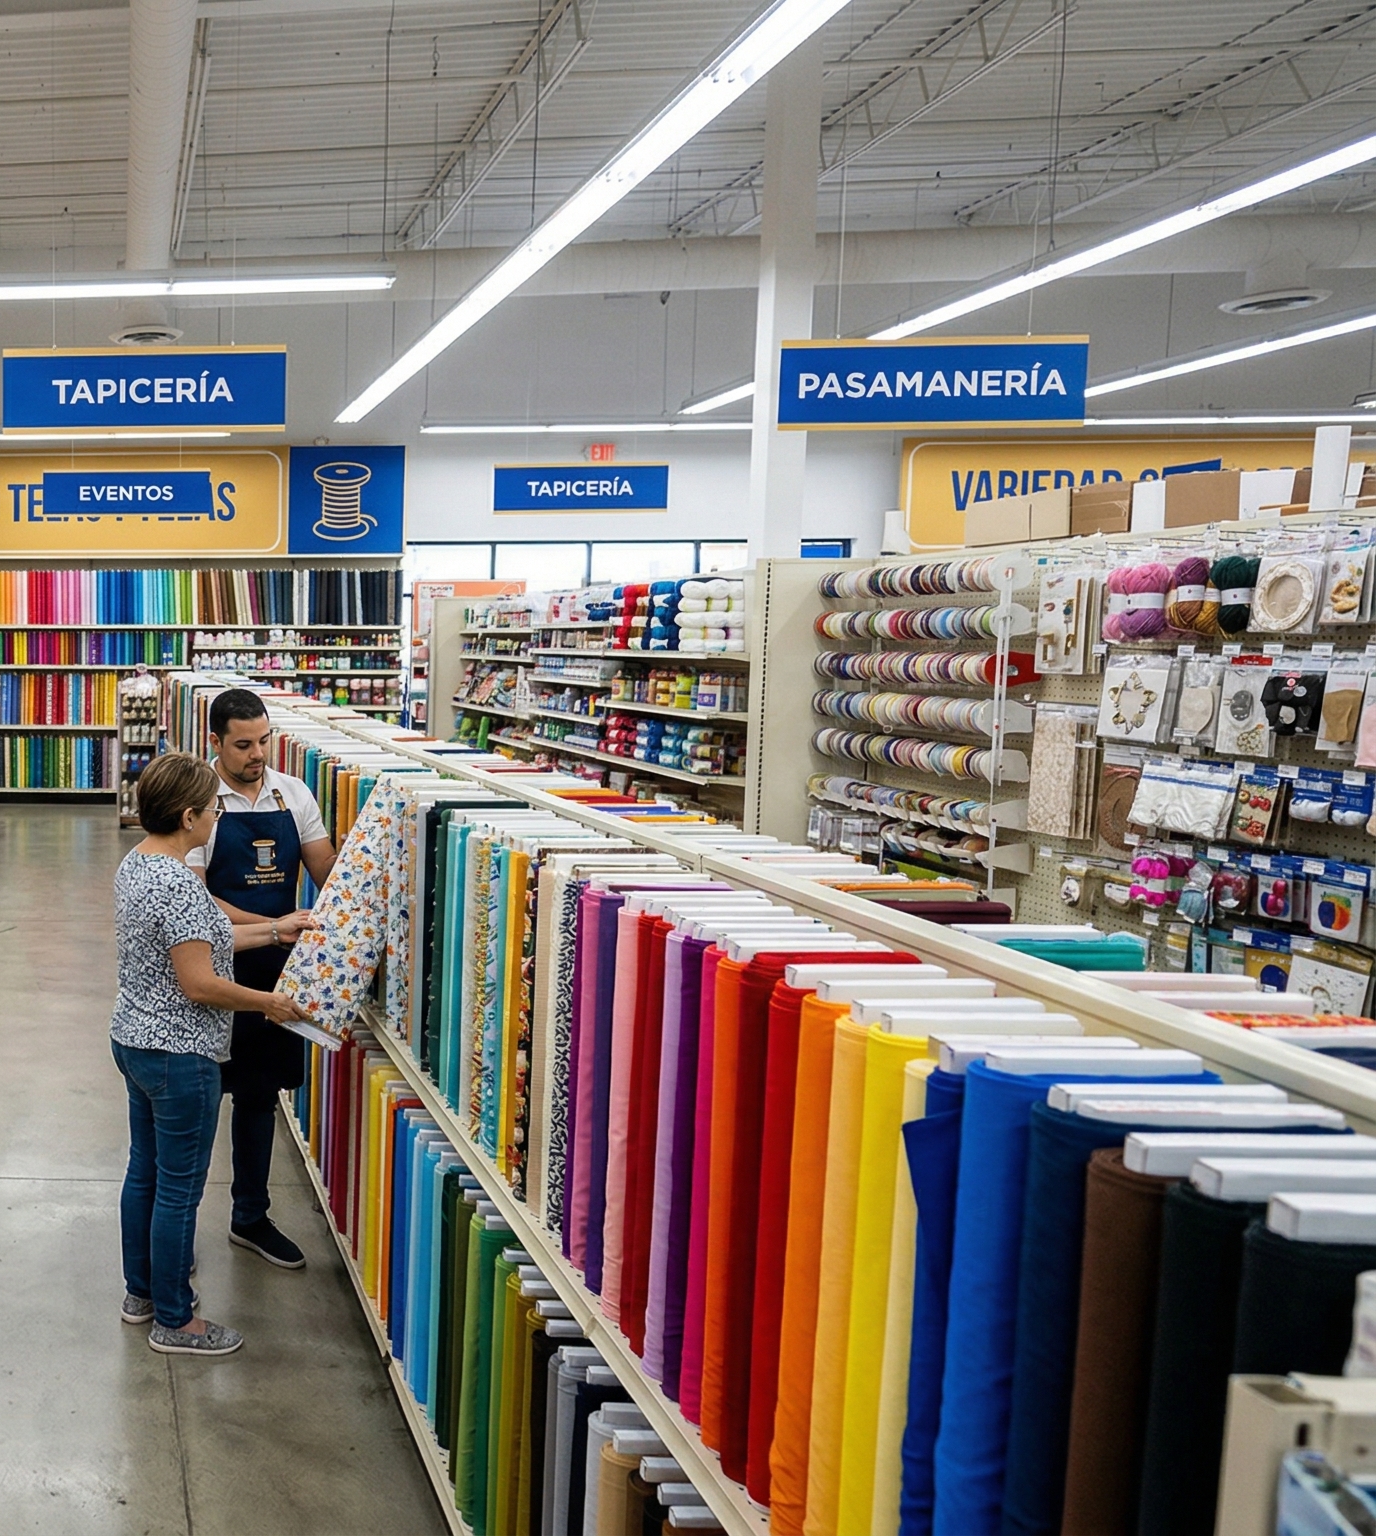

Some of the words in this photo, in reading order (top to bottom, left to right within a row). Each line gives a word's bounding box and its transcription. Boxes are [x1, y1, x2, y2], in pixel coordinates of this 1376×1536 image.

[52, 370, 234, 405] TAPICERÍA
[798, 361, 1067, 399] PASAMANERÍA
[79, 485, 174, 502] EVENTOS
[527, 476, 634, 497] TAPICERÍA
